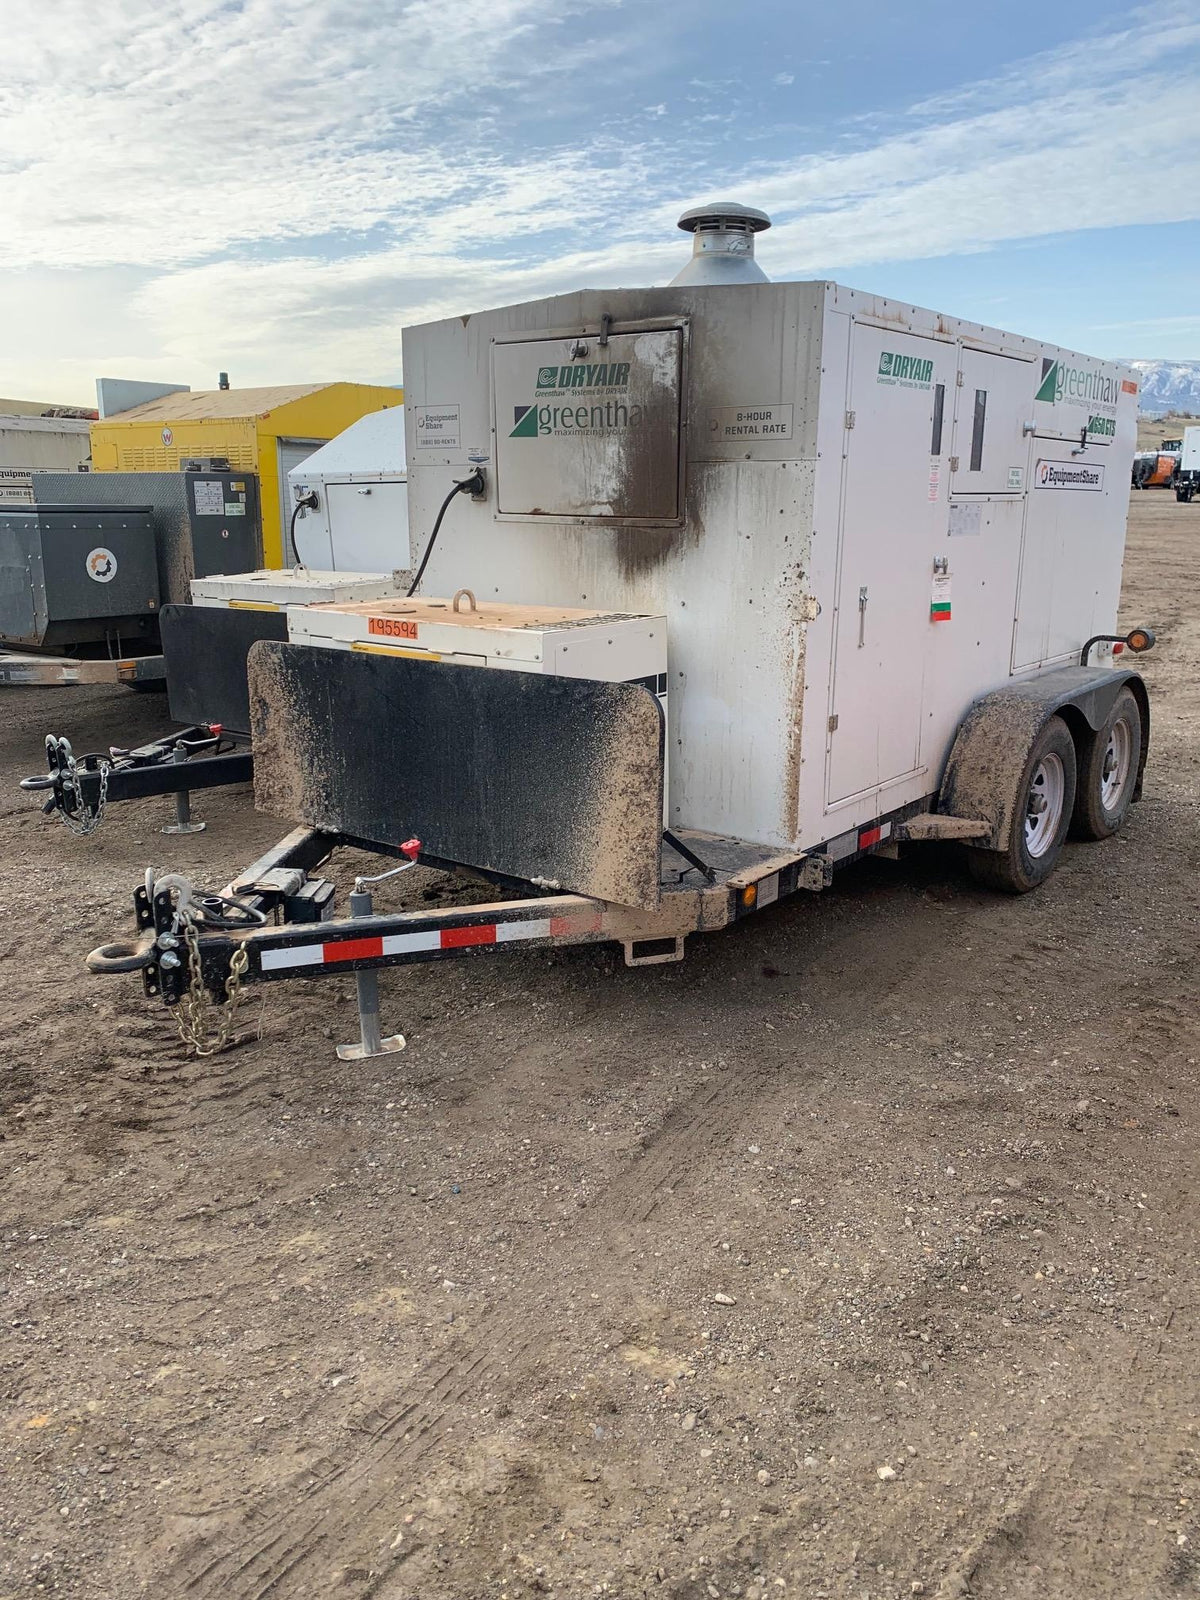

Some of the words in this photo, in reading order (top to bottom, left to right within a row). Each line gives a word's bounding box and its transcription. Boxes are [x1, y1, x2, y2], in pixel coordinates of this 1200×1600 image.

[558, 362, 631, 388] DRYAIR
[892, 354, 934, 382] DRYAIR
[1056, 362, 1119, 404] greenthaw
[571, 388, 595, 397] Systems
[605, 387, 628, 395] DRYAIR
[425, 414, 458, 423] Equipment
[539, 401, 645, 435] greentha
[736, 411, 772, 422] 8-HOUR
[425, 422, 443, 430] Share
[555, 428, 604, 438] maximizing
[725, 425, 759, 435] RENTAL
[762, 423, 787, 434] RATE
[1048, 466, 1100, 485] EquipmentShare
[369, 618, 417, 639] 195594
